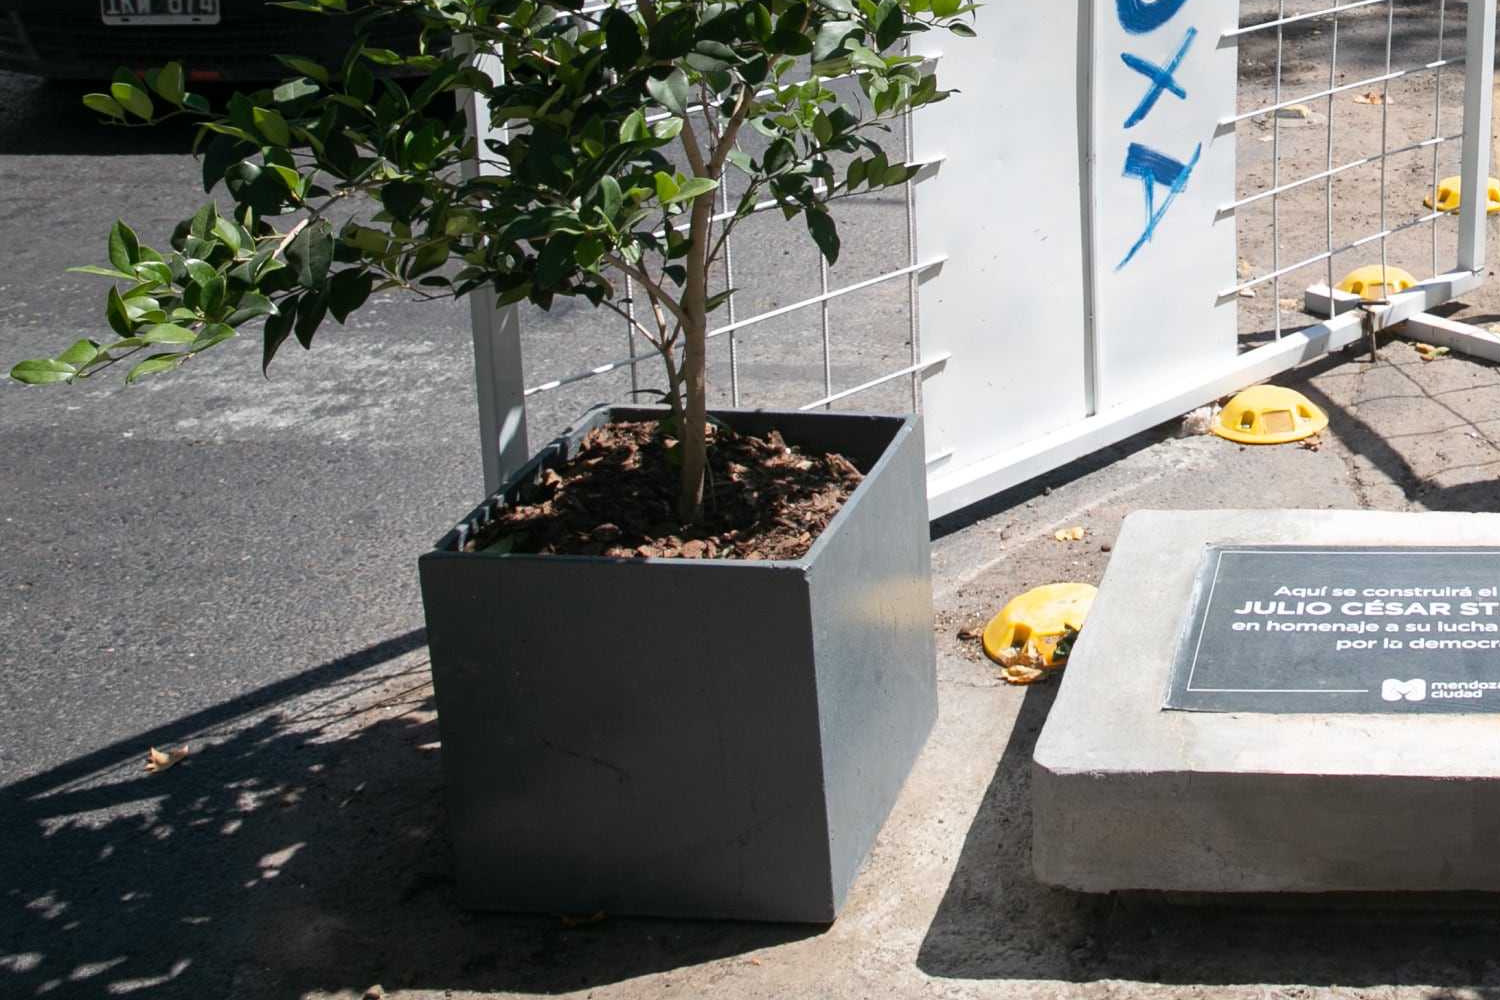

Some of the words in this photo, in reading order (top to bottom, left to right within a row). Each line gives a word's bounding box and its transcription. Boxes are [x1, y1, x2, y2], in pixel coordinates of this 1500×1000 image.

[1274, 586, 1328, 599] Aquí
[1331, 588, 1355, 597] se
[1362, 586, 1472, 598] construirá
[1478, 586, 1497, 597] el
[1234, 601, 1332, 615] JULIO
[1341, 599, 1450, 616] CÉSAR
[1231, 621, 1260, 631] en
[1266, 620, 1379, 634] homenaje
[1385, 622, 1399, 632] a
[1405, 622, 1431, 632] su
[1437, 621, 1499, 632] lucha
[1335, 638, 1377, 651] por
[1383, 637, 1402, 649] la
[1431, 690, 1483, 699] ciudad
